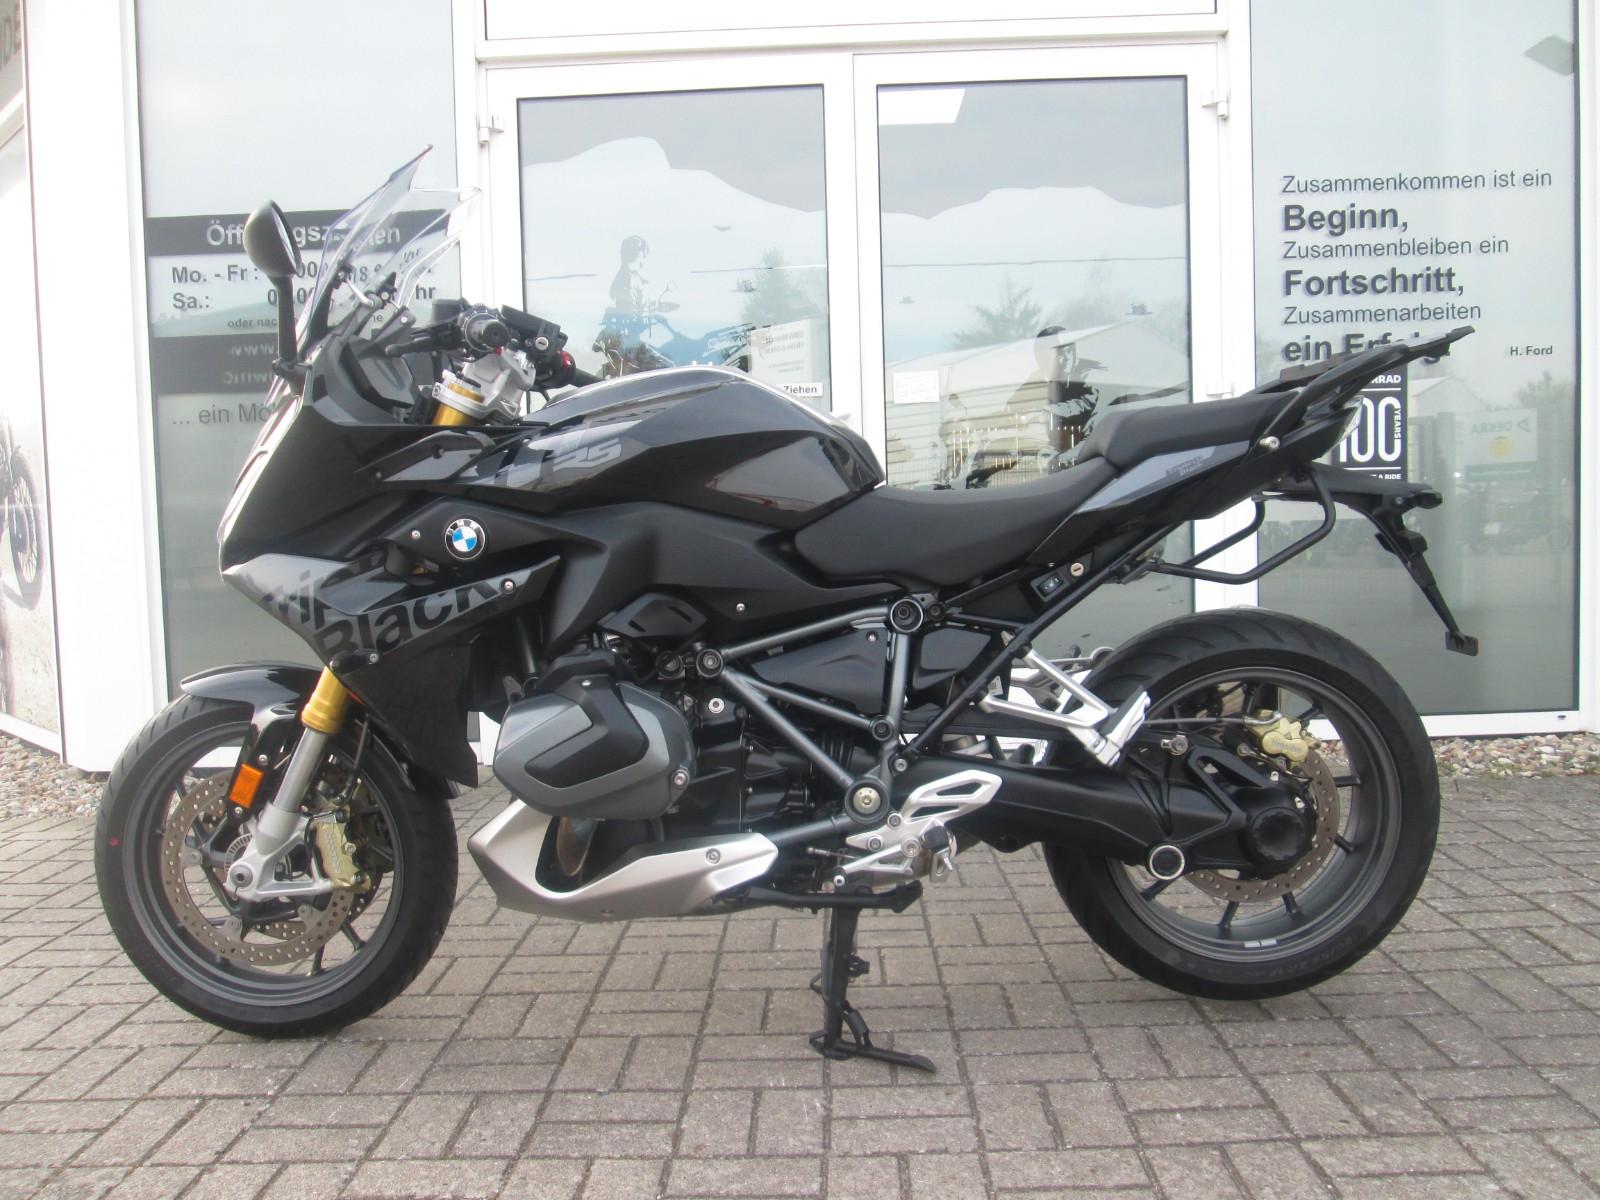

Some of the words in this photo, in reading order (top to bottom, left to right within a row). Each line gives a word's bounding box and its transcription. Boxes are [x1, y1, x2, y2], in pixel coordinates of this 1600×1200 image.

[1282, 173, 1486, 193] Zusammenkommen
[1493, 169, 1516, 188] ist
[1522, 169, 1552, 187] ein
[1283, 203, 1409, 237] Beginn,
[1282, 236, 1473, 259] Zusammenbleiben
[1479, 236, 1509, 254] ein
[172, 266, 207, 284] Mo.
[228, 265, 249, 282] Fr
[1284, 265, 1465, 297] Fortschritt,
[172, 293, 210, 310] Sa.:
[227, 318, 254, 329] oder
[256, 318, 278, 328] nac
[1283, 303, 1482, 325] Zusammenarbeiten
[1284, 335, 1332, 361] ein
[1510, 346, 1523, 357] H.
[1525, 345, 1553, 357] Ford
[198, 406, 230, 424] ein
[1393, 408, 1402, 440] YEARS
[446, 518, 482, 537] BMW
